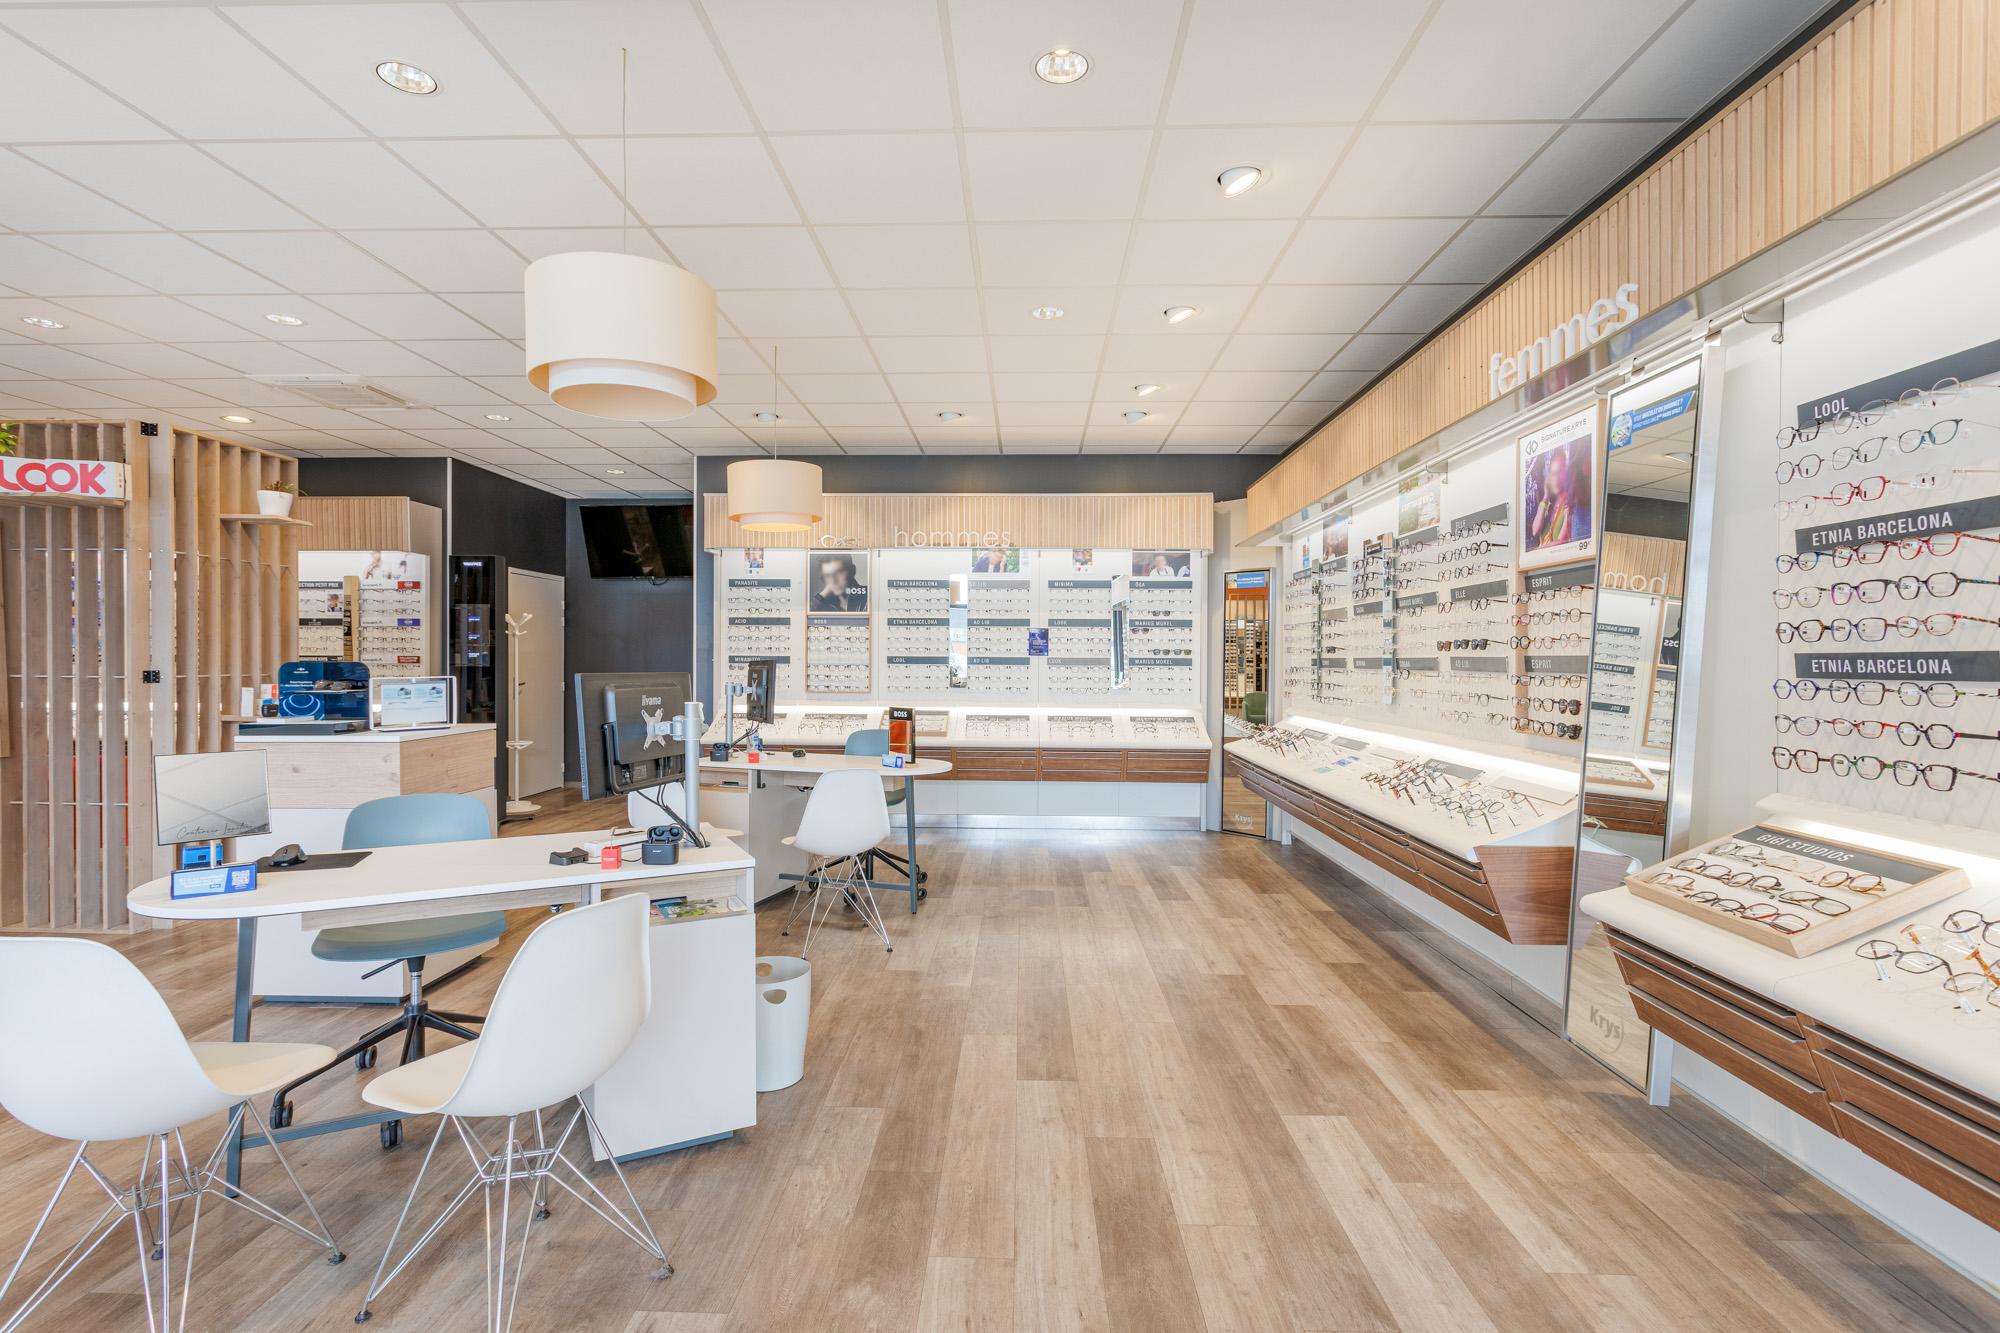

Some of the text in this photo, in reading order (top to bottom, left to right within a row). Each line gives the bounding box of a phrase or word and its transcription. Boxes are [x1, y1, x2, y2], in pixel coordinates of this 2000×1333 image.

[1489, 283, 1639, 400] femmes
[1814, 397, 1849, 419] LOOL
[894, 526, 1010, 548] hommes
[1812, 511, 1953, 546] ETNIA BARCELONA
[845, 587, 867, 595] BOSS
[1531, 576, 1552, 588] ESPRIT
[1455, 590, 1466, 599] ELLE
[1531, 659, 1552, 669] ESPRIT
[1811, 658, 1952, 675] ETNIA BARCELONA
[893, 710, 908, 718] BOSS
[1756, 834, 1855, 862] GIGI STUDIOS
[1590, 1006, 1621, 1039] Krys
